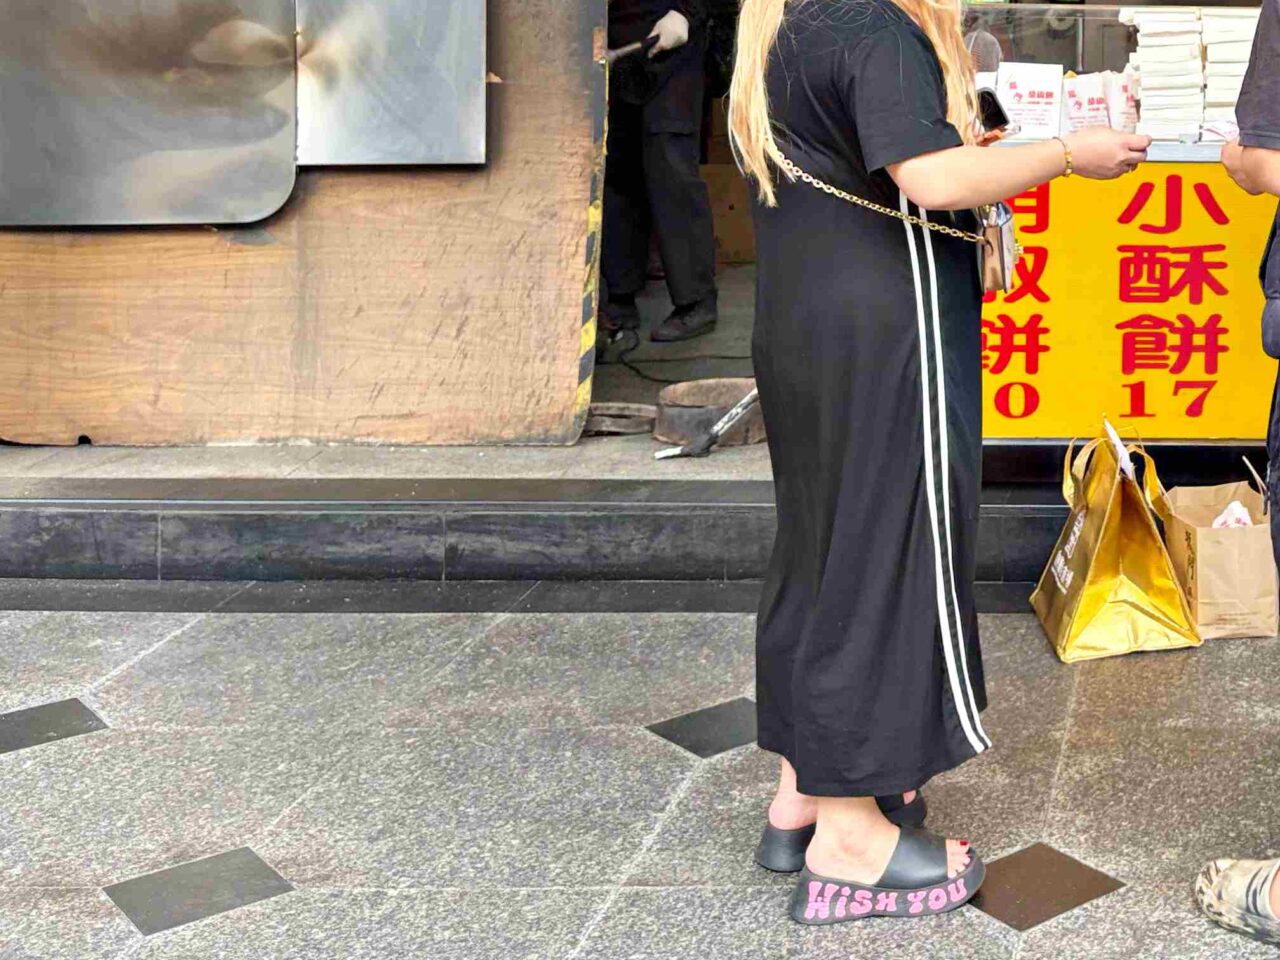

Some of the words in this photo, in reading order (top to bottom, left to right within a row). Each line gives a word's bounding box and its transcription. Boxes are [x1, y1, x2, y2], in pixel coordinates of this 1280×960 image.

[1115, 173, 1231, 376] 小酥餅
[993, 381, 1041, 420] 0
[1118, 379, 1219, 419] 17
[906, 878, 968, 914] YOU
